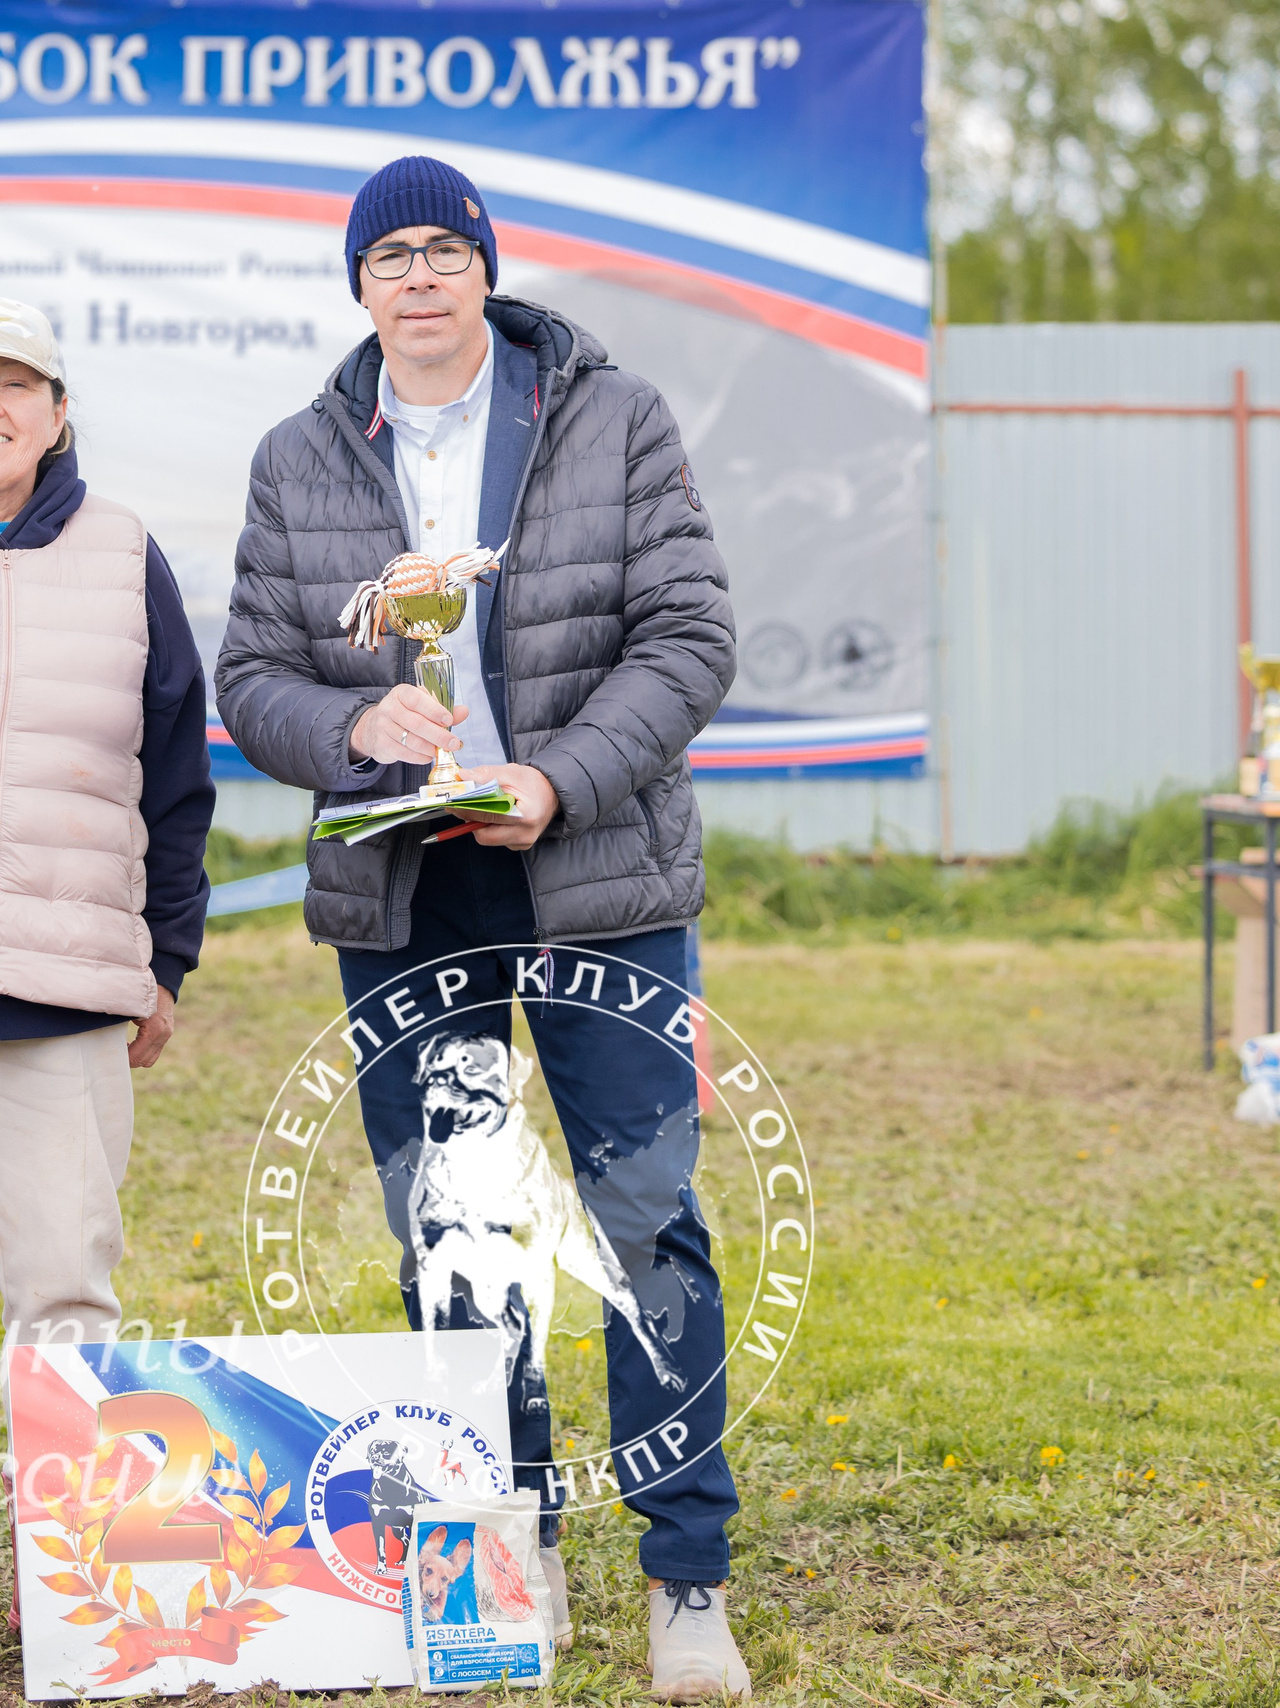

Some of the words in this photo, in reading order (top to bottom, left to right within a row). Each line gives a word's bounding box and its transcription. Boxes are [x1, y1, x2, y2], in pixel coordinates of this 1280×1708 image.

[87, 300, 319, 356] Новгород
[97, 1390, 223, 1564] 2
[311, 1410, 380, 1521] РОТВЕЙЛЕР
[395, 1405, 452, 1427] КЛУБ
[327, 1553, 402, 1605] НИЖЕГО
[437, 1627, 496, 1640] STATERA
[457, 1669, 492, 1678] ЛОСОСЕМ
[463, 1658, 496, 1666] ВЗРОСЛЫХ
[520, 1667, 534, 1675] 800
